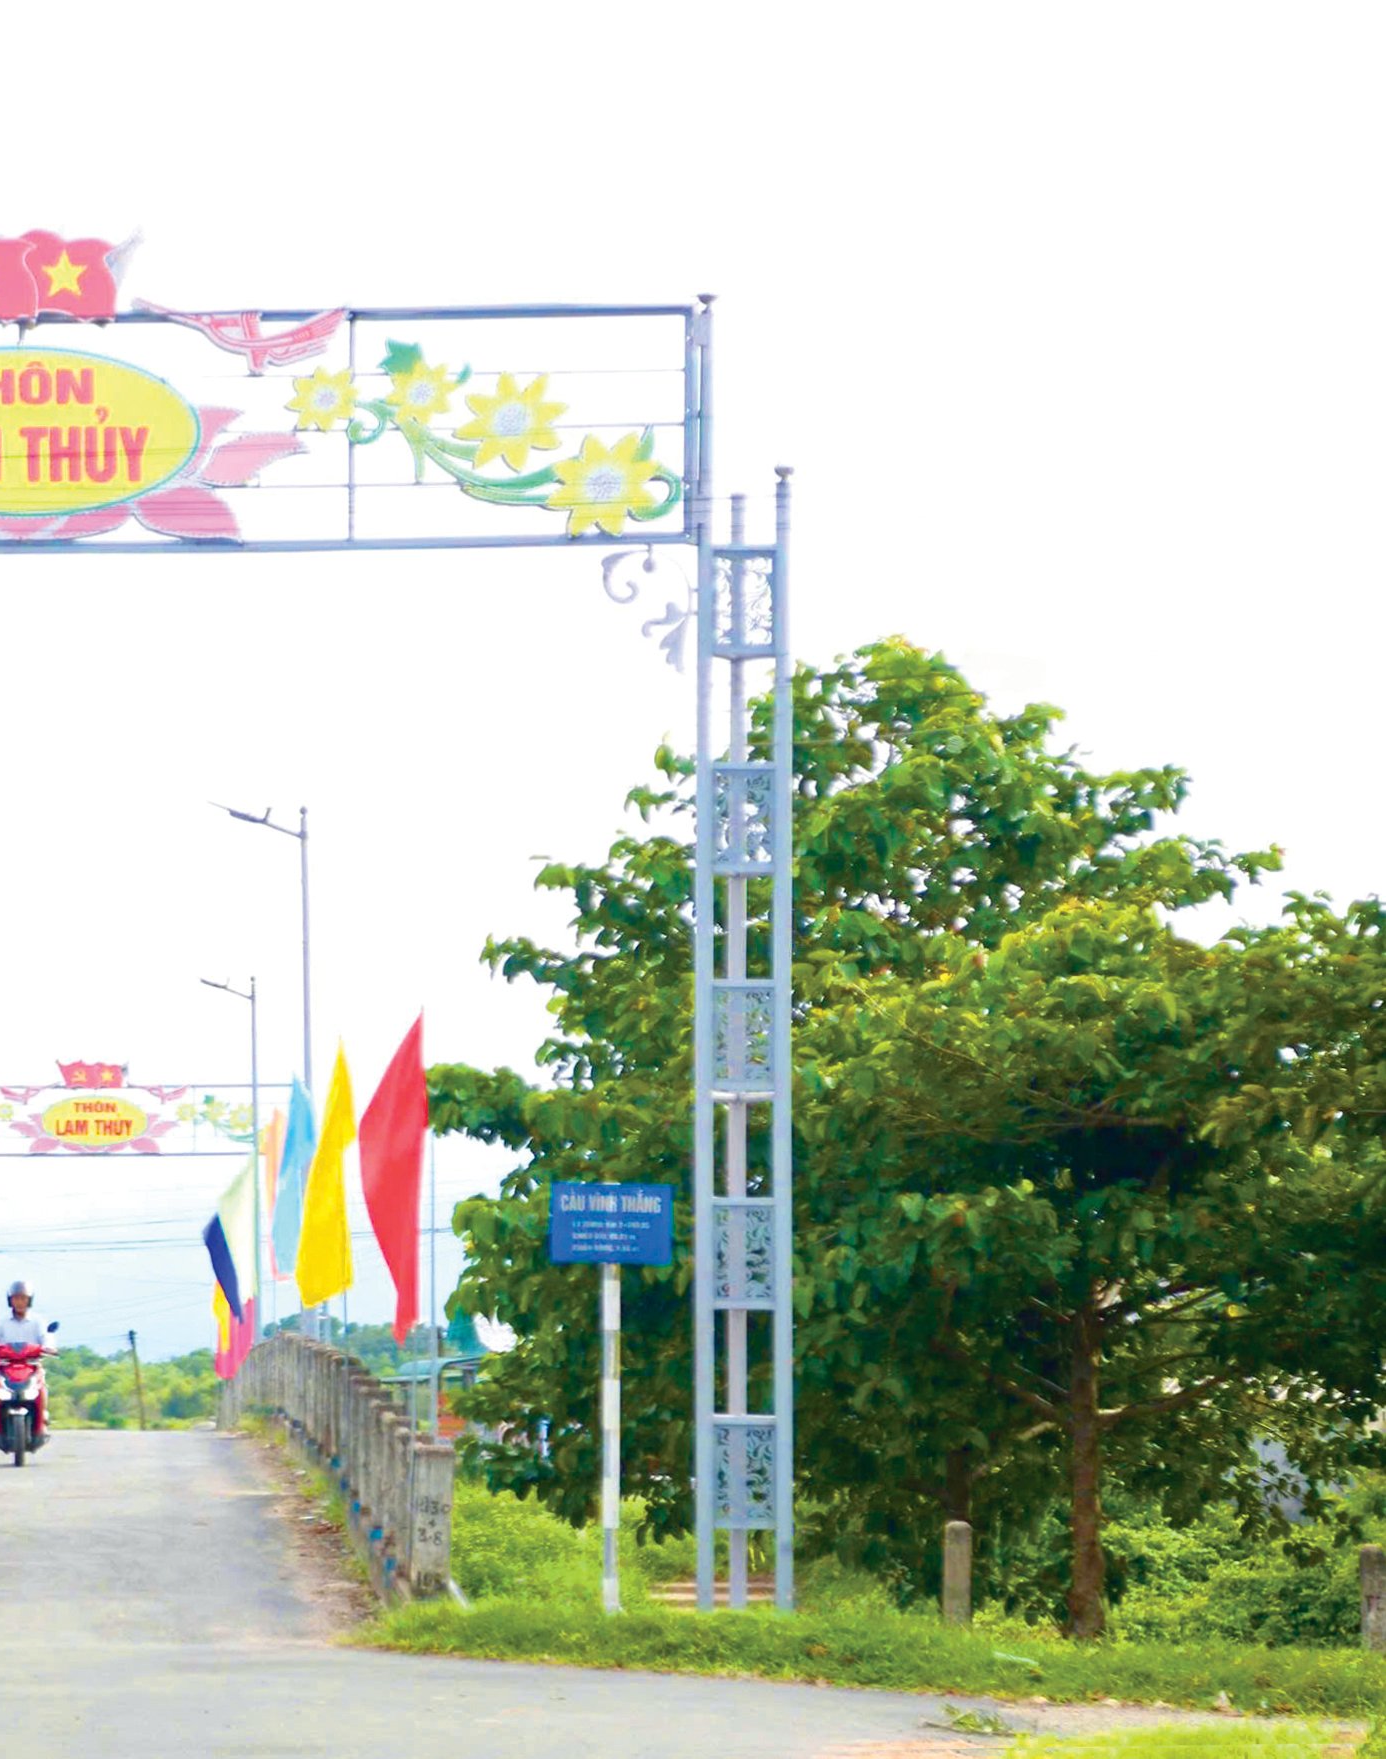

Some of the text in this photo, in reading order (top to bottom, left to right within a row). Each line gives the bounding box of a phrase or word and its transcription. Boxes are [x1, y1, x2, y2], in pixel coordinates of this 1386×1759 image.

[20, 407, 150, 483] THỦY
[74, 1101, 117, 1113] THÔN
[55, 1119, 88, 1136] LAM
